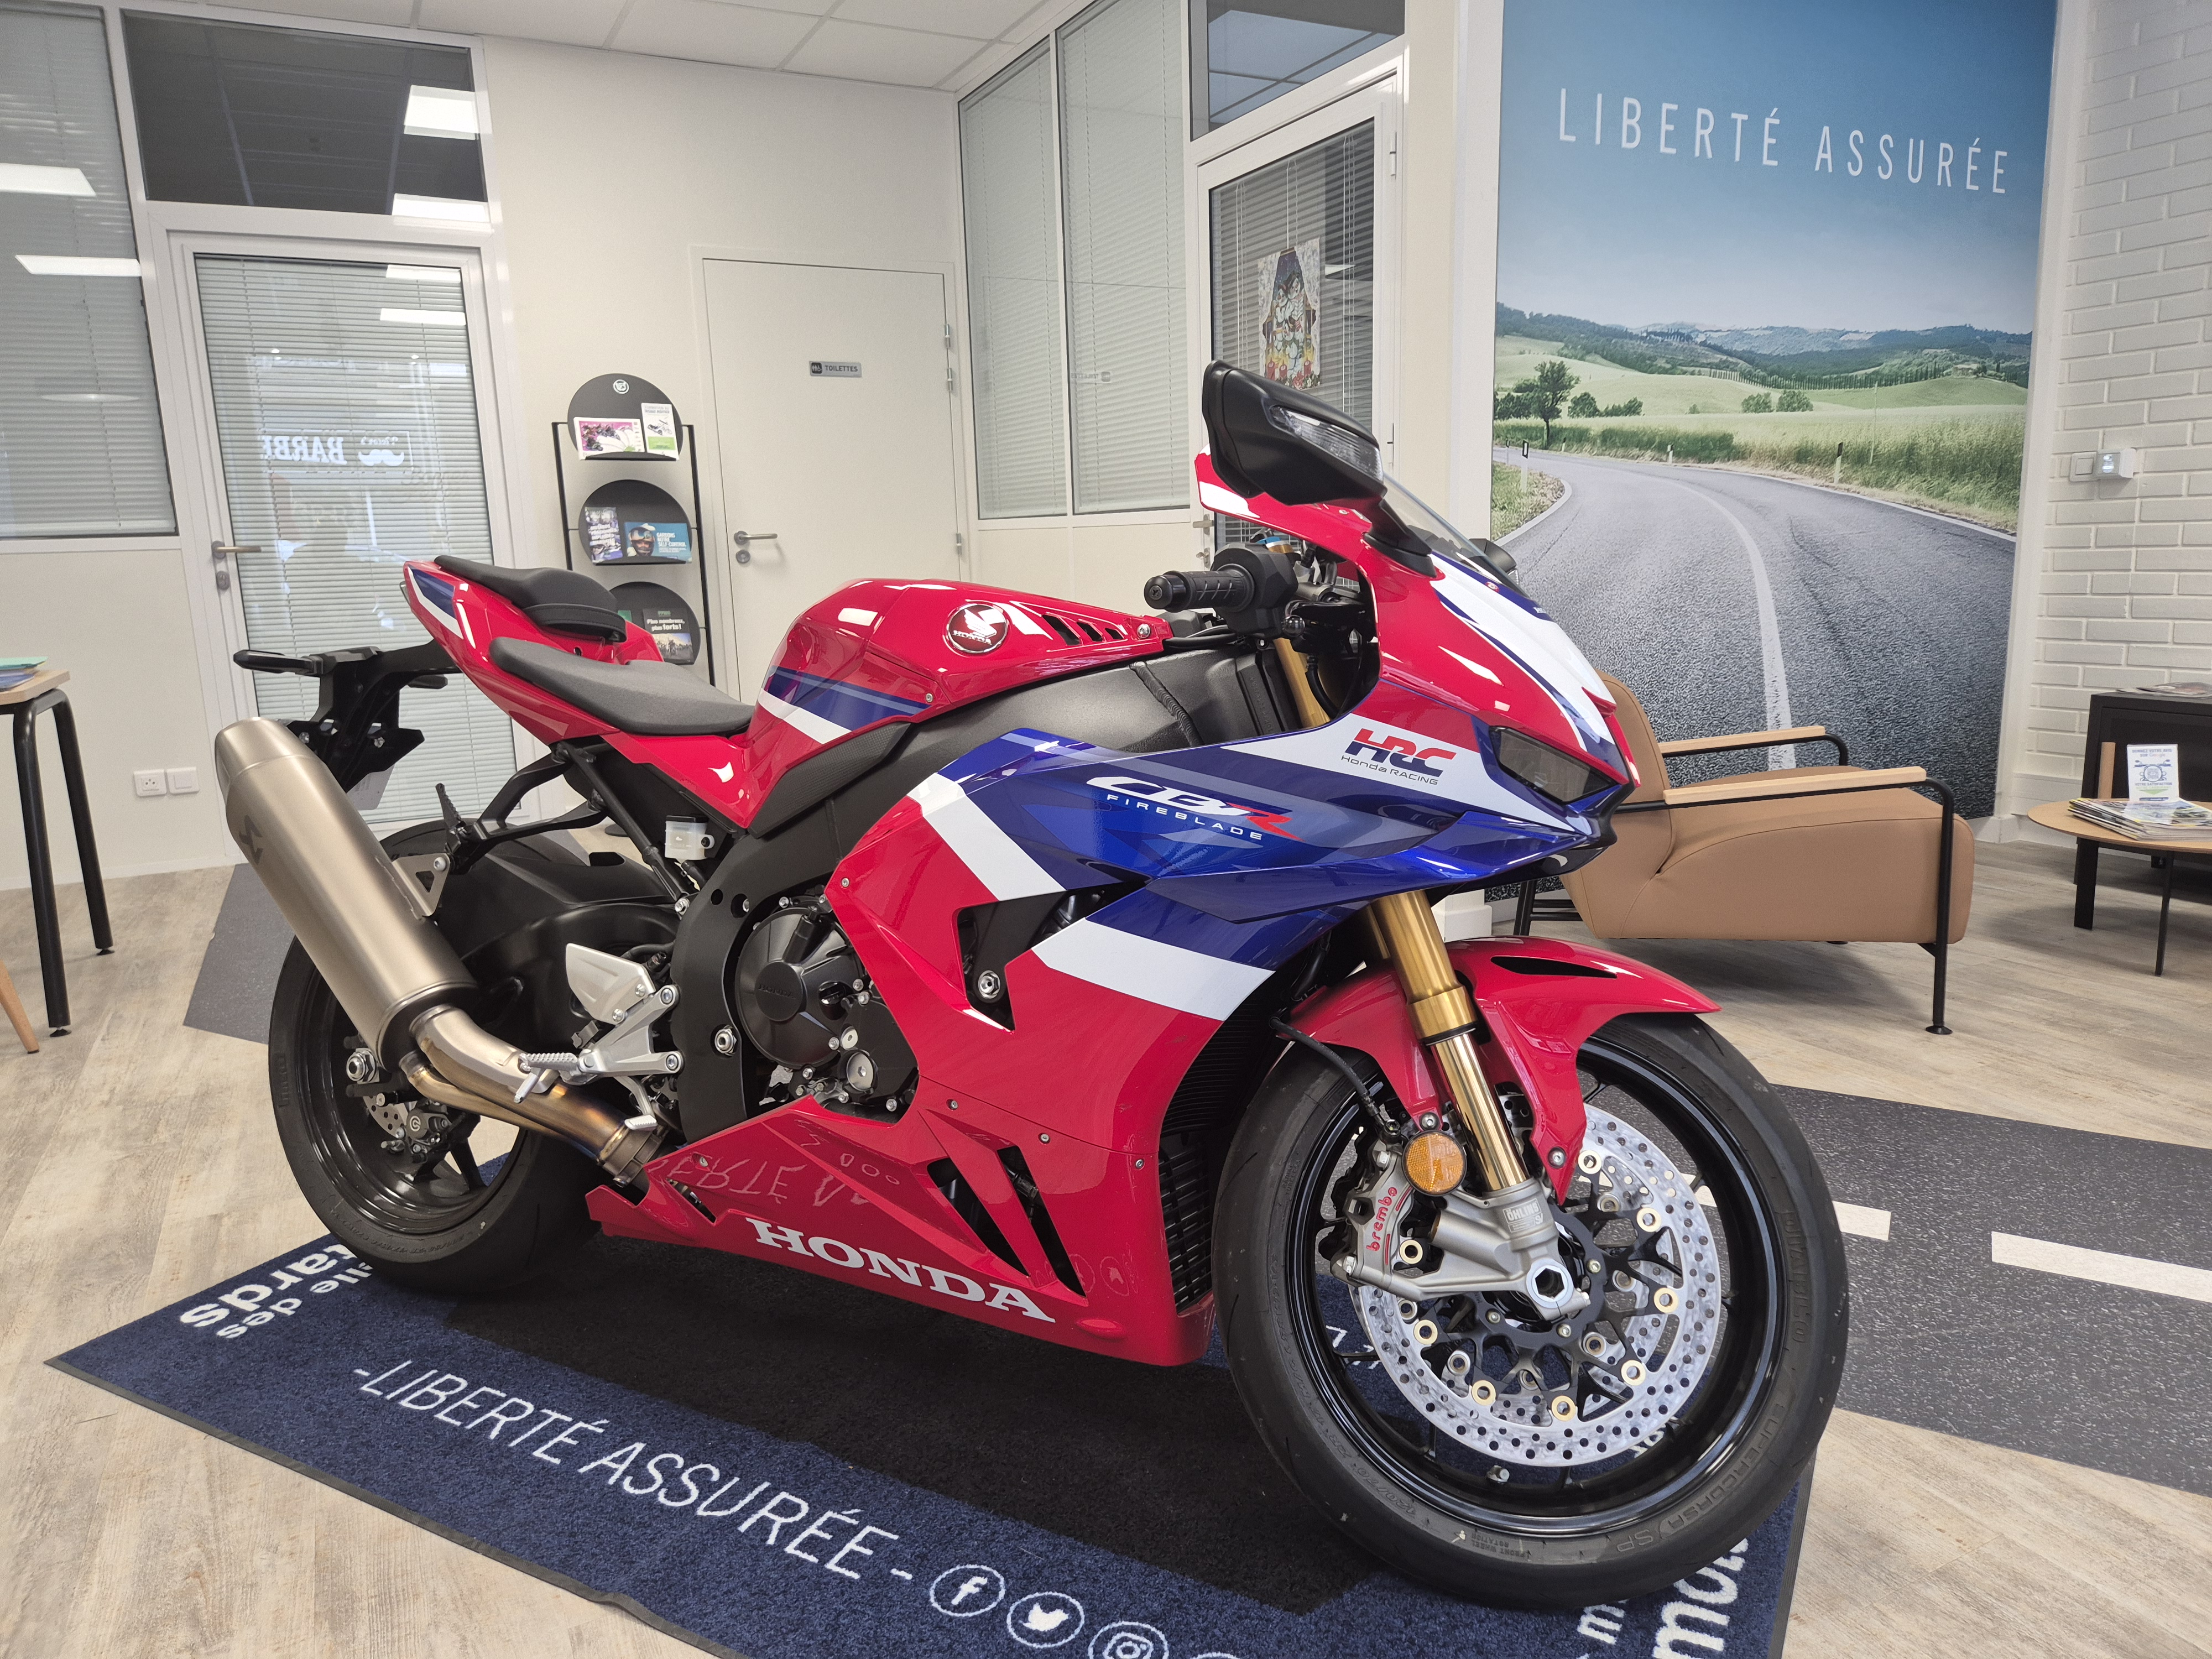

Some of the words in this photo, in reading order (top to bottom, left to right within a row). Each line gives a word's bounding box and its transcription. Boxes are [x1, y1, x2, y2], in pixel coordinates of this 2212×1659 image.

[1559, 88, 1780, 166] LIBERTÉ
[1814, 126, 2008, 194] ASSURÉE
[1341, 755, 1387, 774] Honda
[1390, 768, 1438, 785] RACING
[1345, 728, 1457, 777] HRC
[1107, 794, 1262, 840] FIREBLADE
[1366, 1187, 1397, 1251] brembo
[1505, 1201, 1540, 1221] ÖHLINS
[745, 1217, 1056, 1323] HONDA
[216, 1298, 302, 1338] des
[578, 1442, 899, 1579] ASSURÉE
[1617, 1529, 1653, 1552] SP
